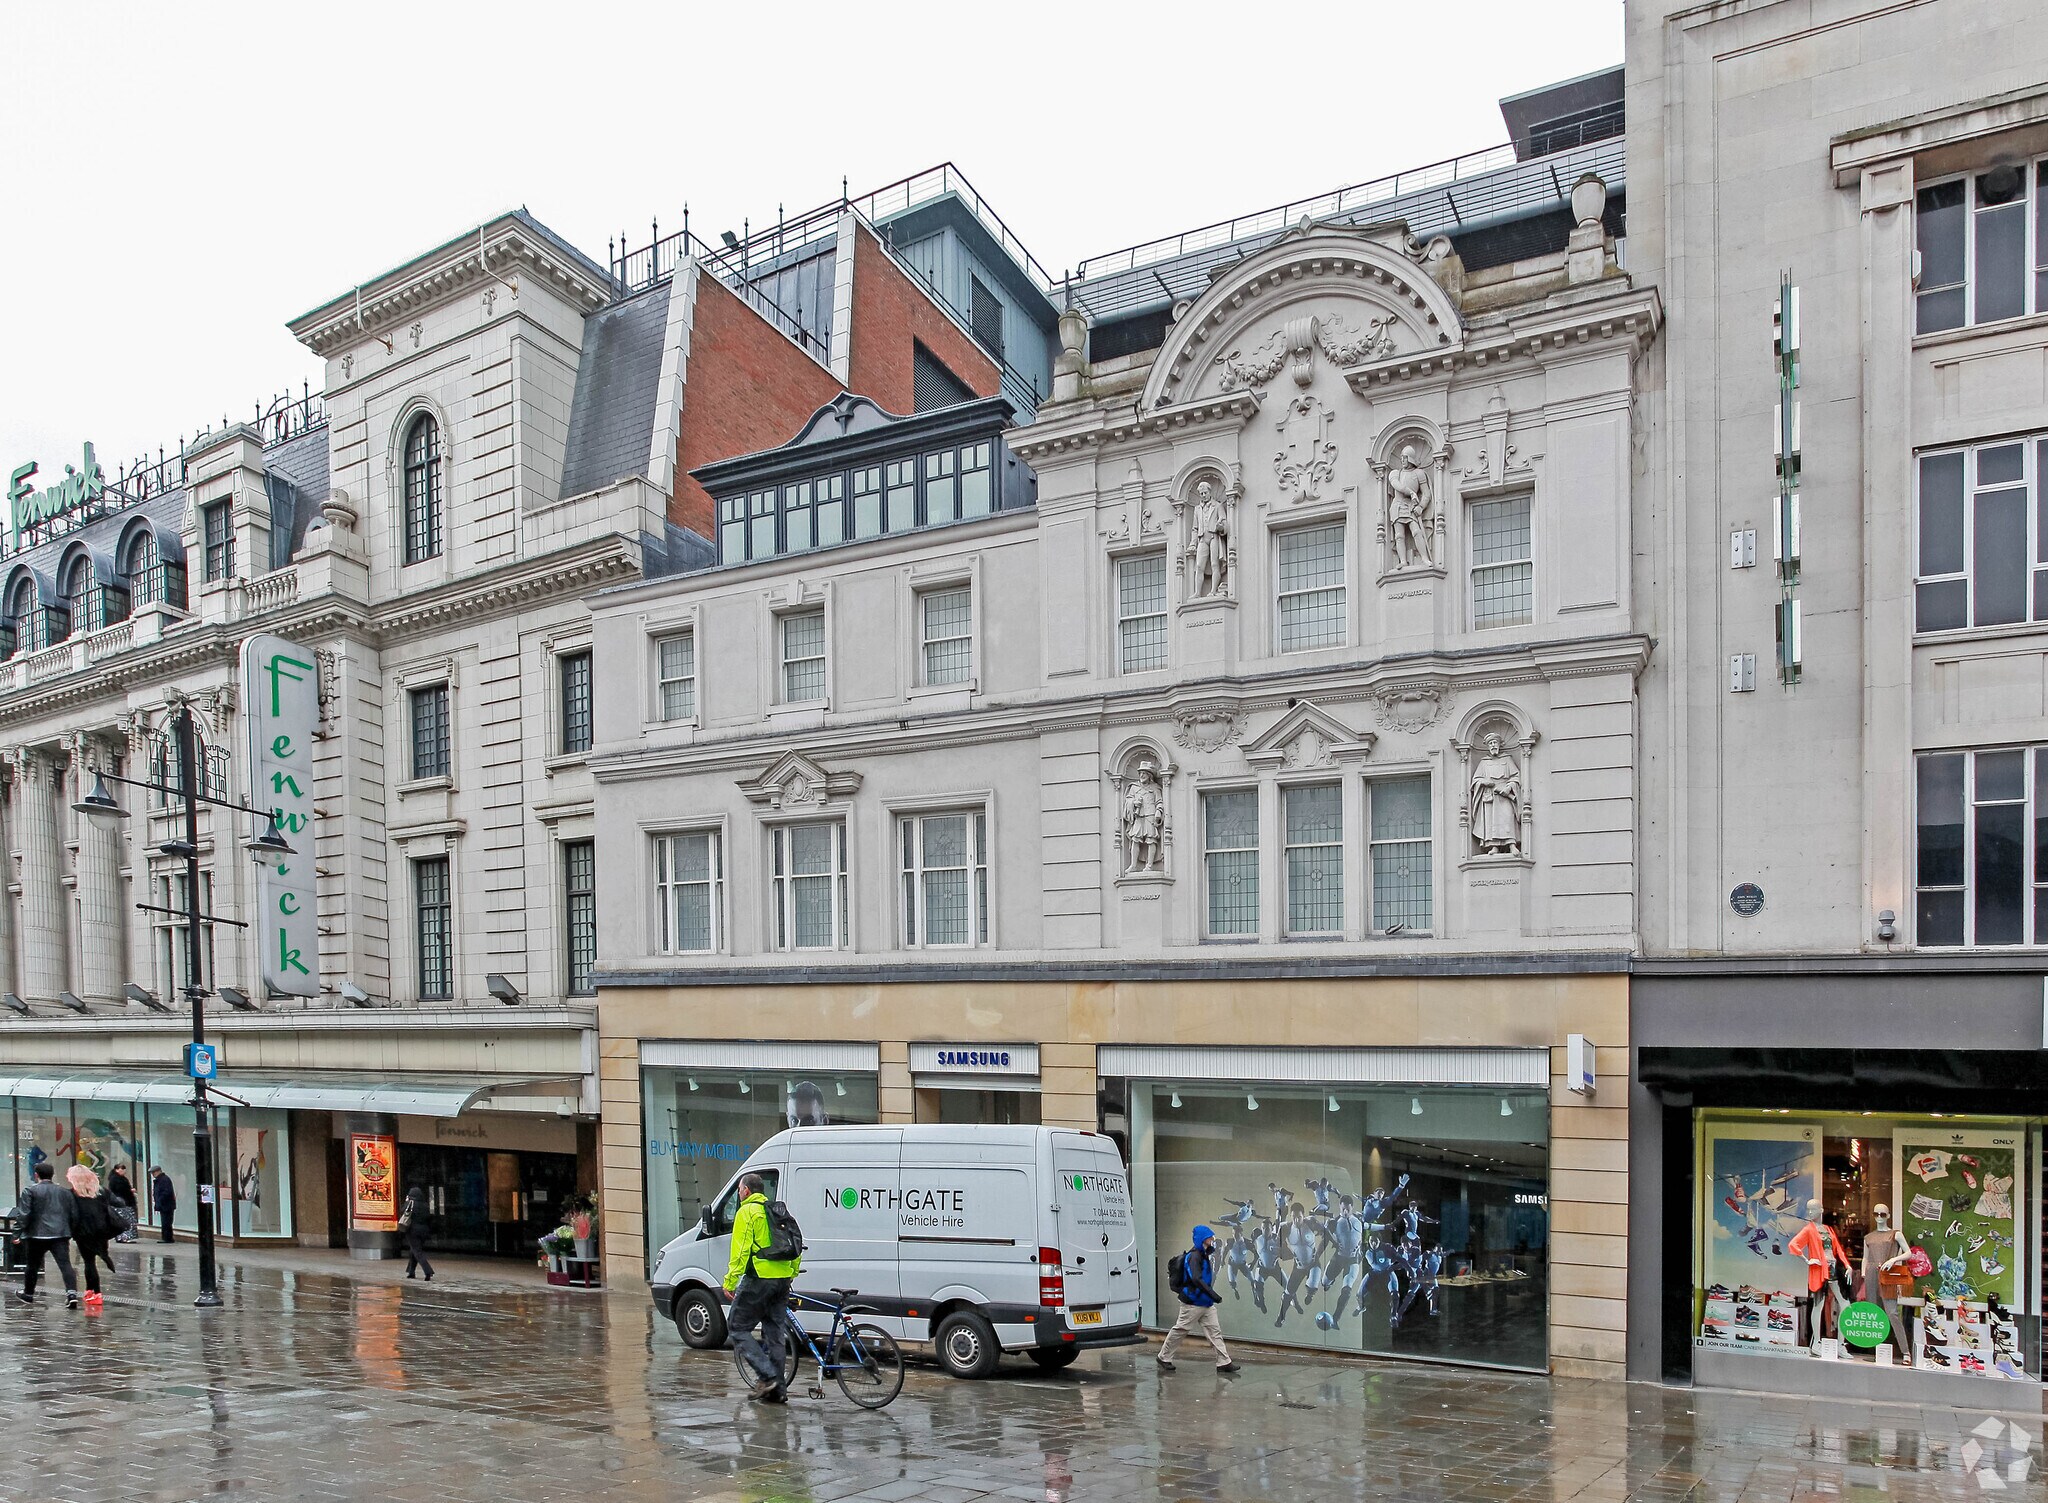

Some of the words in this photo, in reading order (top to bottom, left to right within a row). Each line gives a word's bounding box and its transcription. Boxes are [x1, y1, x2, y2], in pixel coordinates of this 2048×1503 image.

[7, 441, 103, 552] Fenwick
[937, 1051, 1010, 1066] SAMSUNG
[651, 1140, 674, 1156] BUY
[677, 1141, 702, 1159] ANY
[1063, 1174, 1123, 1194] NORTHGATE
[824, 1187, 964, 1211] NORTHGATE
[900, 1214, 939, 1227] Vehicle
[942, 1215, 964, 1228] Hire
[1851, 1311, 1878, 1320] NEW
[1844, 1318, 1885, 1329] OFFERS
[1846, 1329, 1883, 1339] INSTORE
